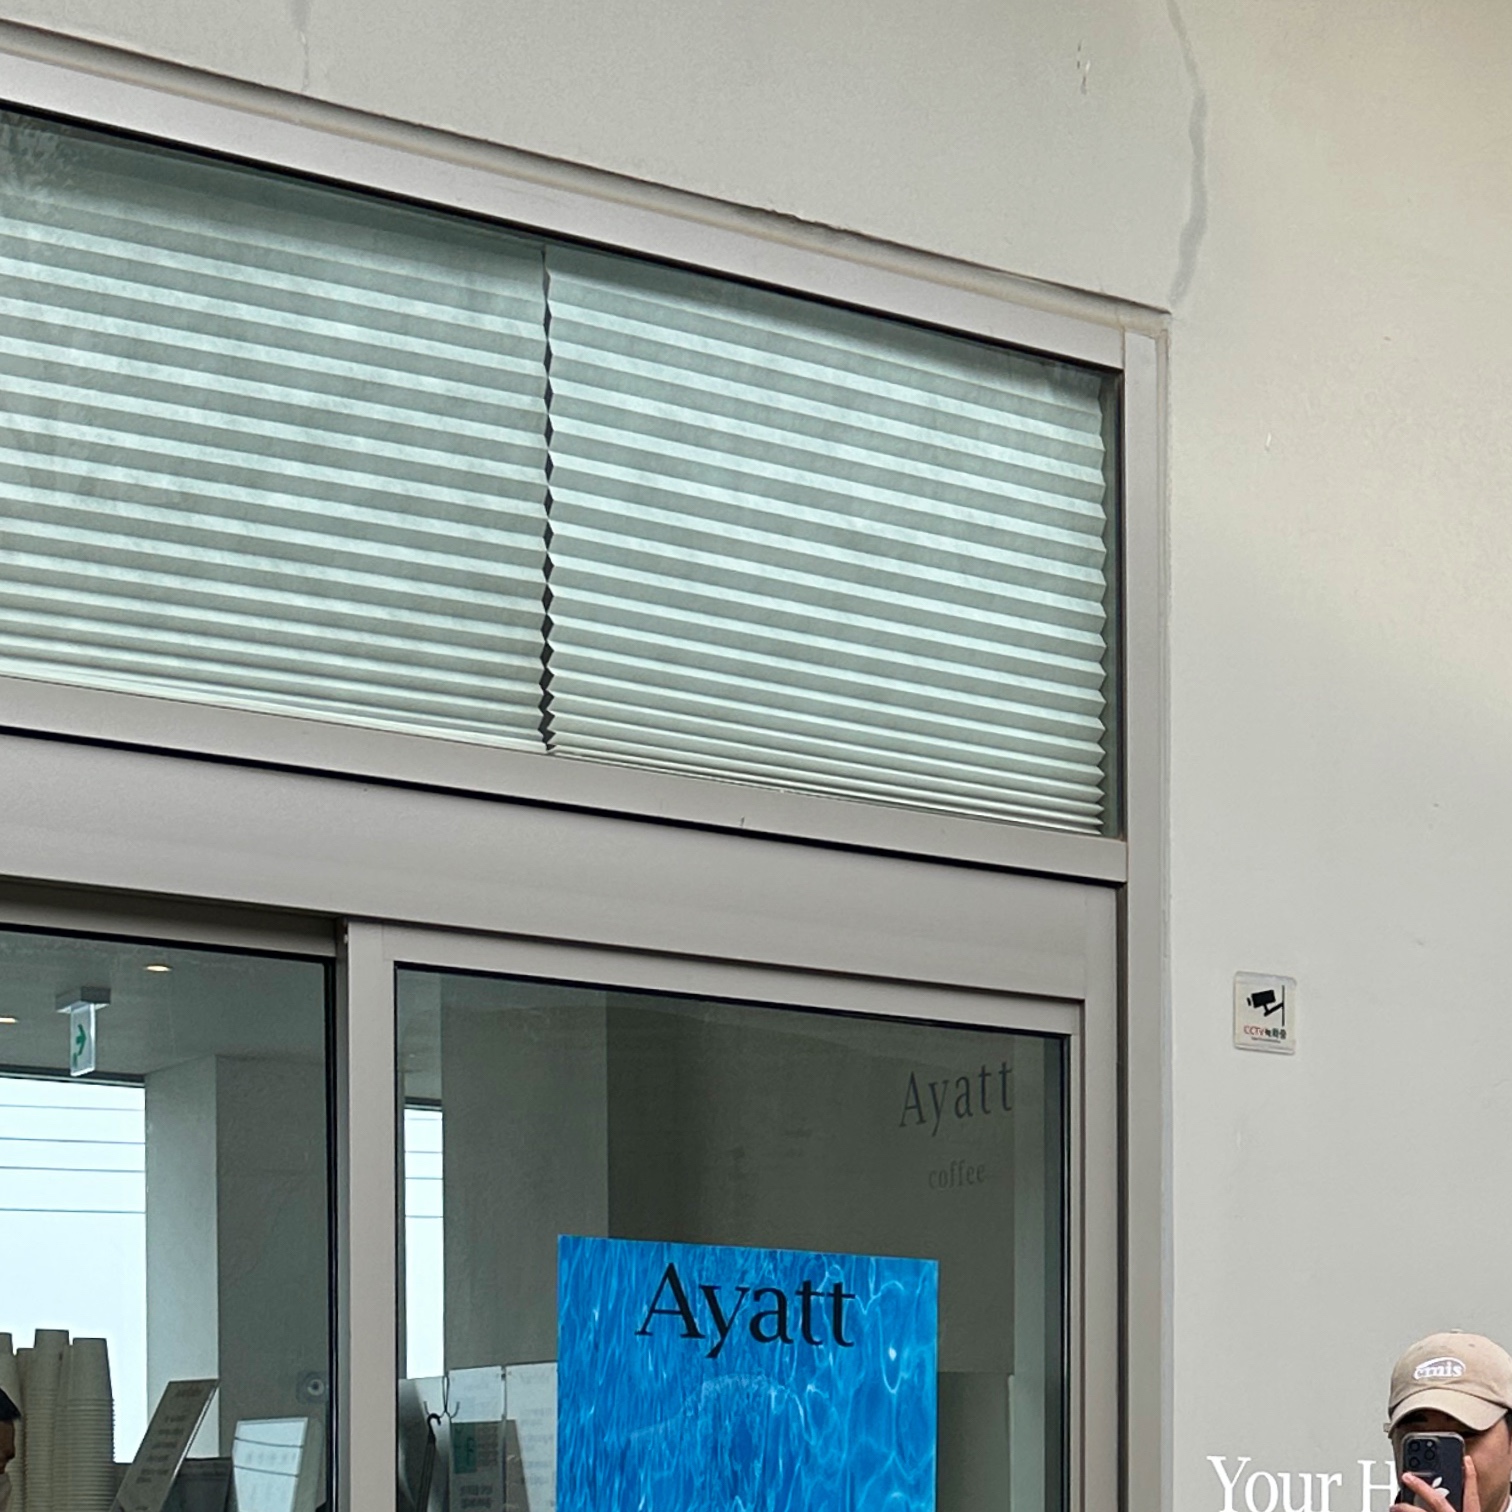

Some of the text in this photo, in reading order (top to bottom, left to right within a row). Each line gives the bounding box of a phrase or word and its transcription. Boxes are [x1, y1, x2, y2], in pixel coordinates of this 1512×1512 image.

[899, 1061, 1012, 1137] Ayatt
[928, 1159, 985, 1189] coffee
[634, 1262, 856, 1359] Ayatt
